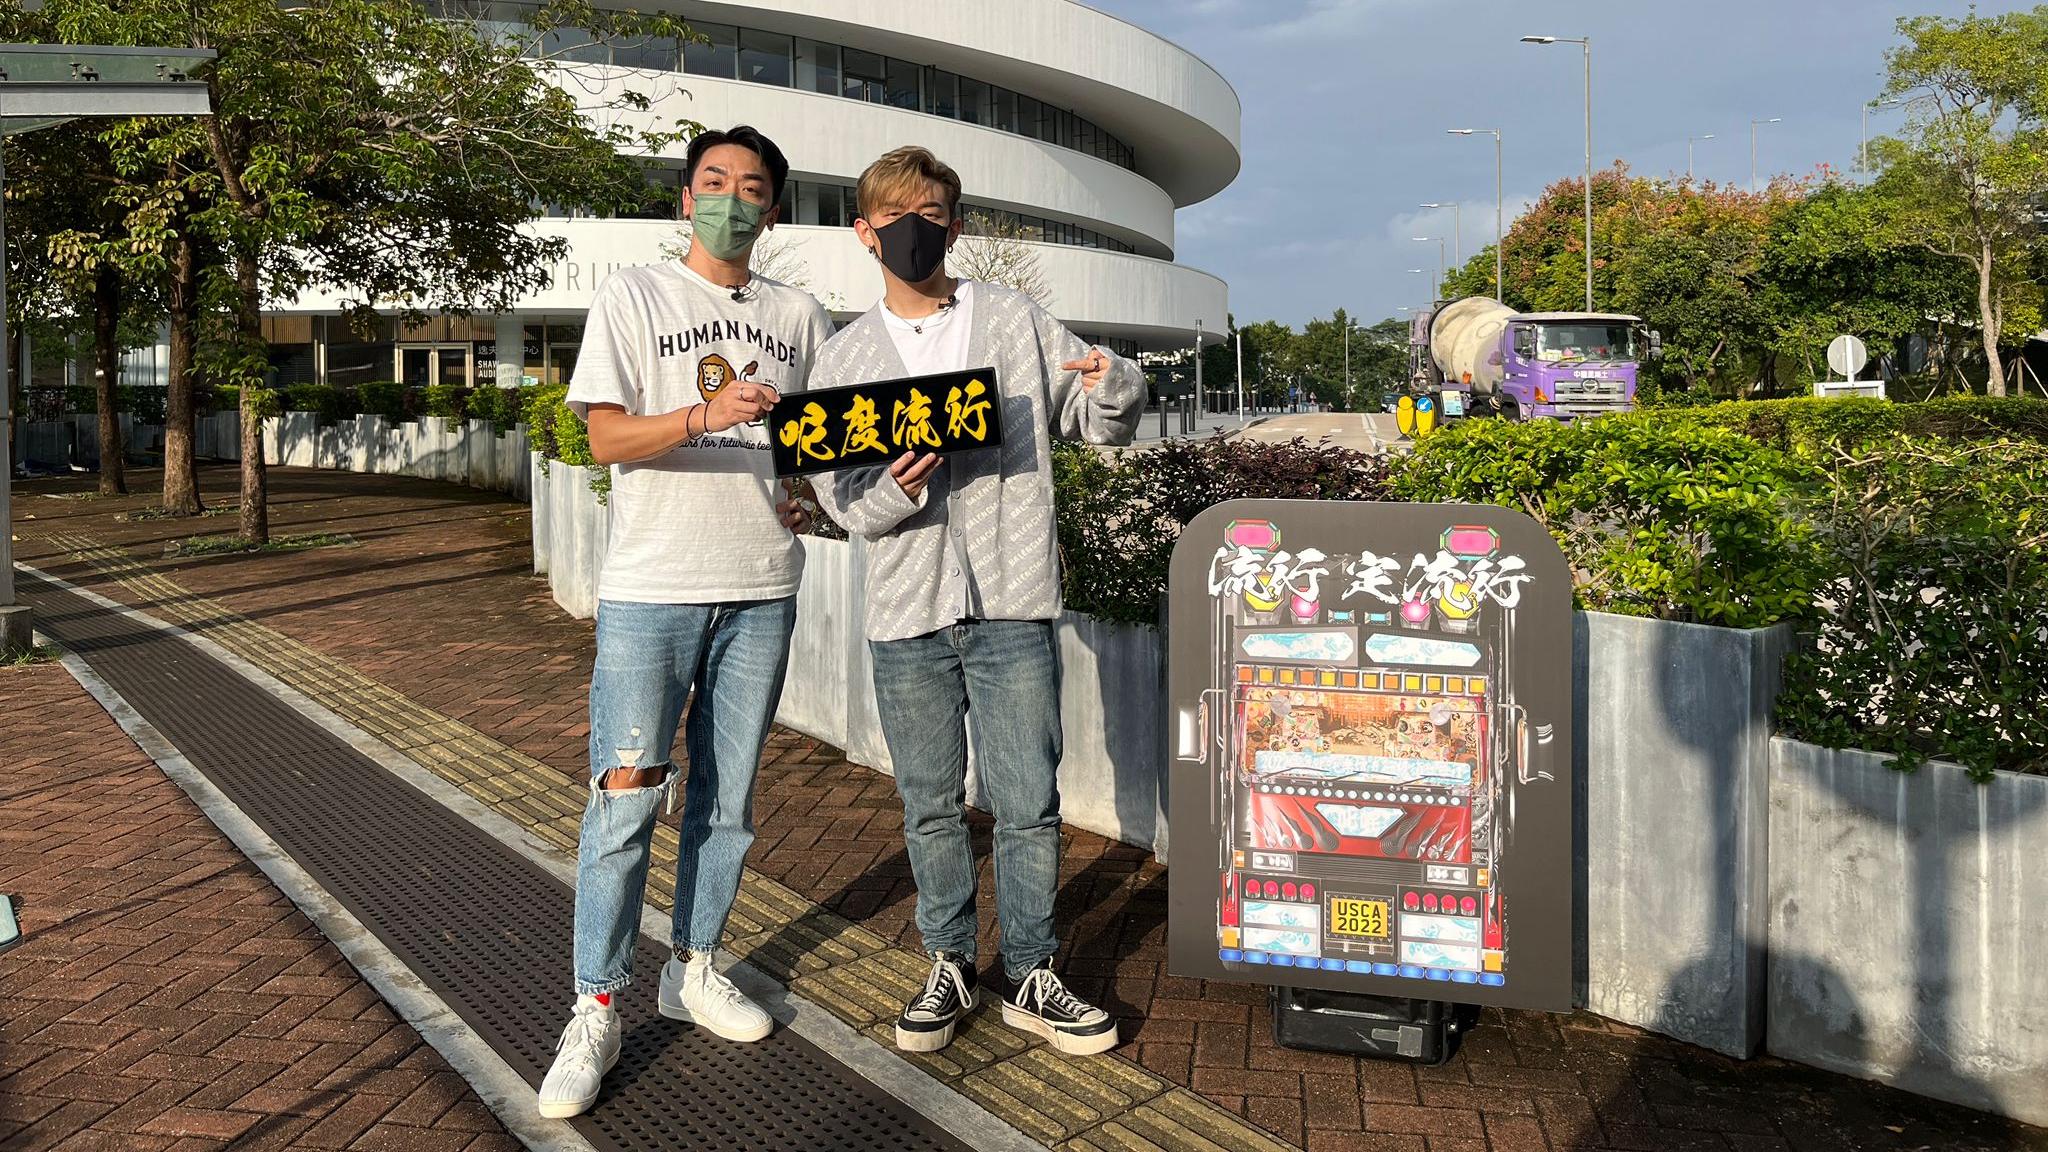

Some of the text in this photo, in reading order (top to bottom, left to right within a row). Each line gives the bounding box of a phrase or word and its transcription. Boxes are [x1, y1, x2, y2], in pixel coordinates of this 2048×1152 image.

[658, 319, 797, 368] HUMAN MADE
[478, 360, 499, 369] SHAW
[700, 436, 717, 449] for
[1337, 901, 1381, 919] USCA
[1337, 917, 1382, 934] 2022
